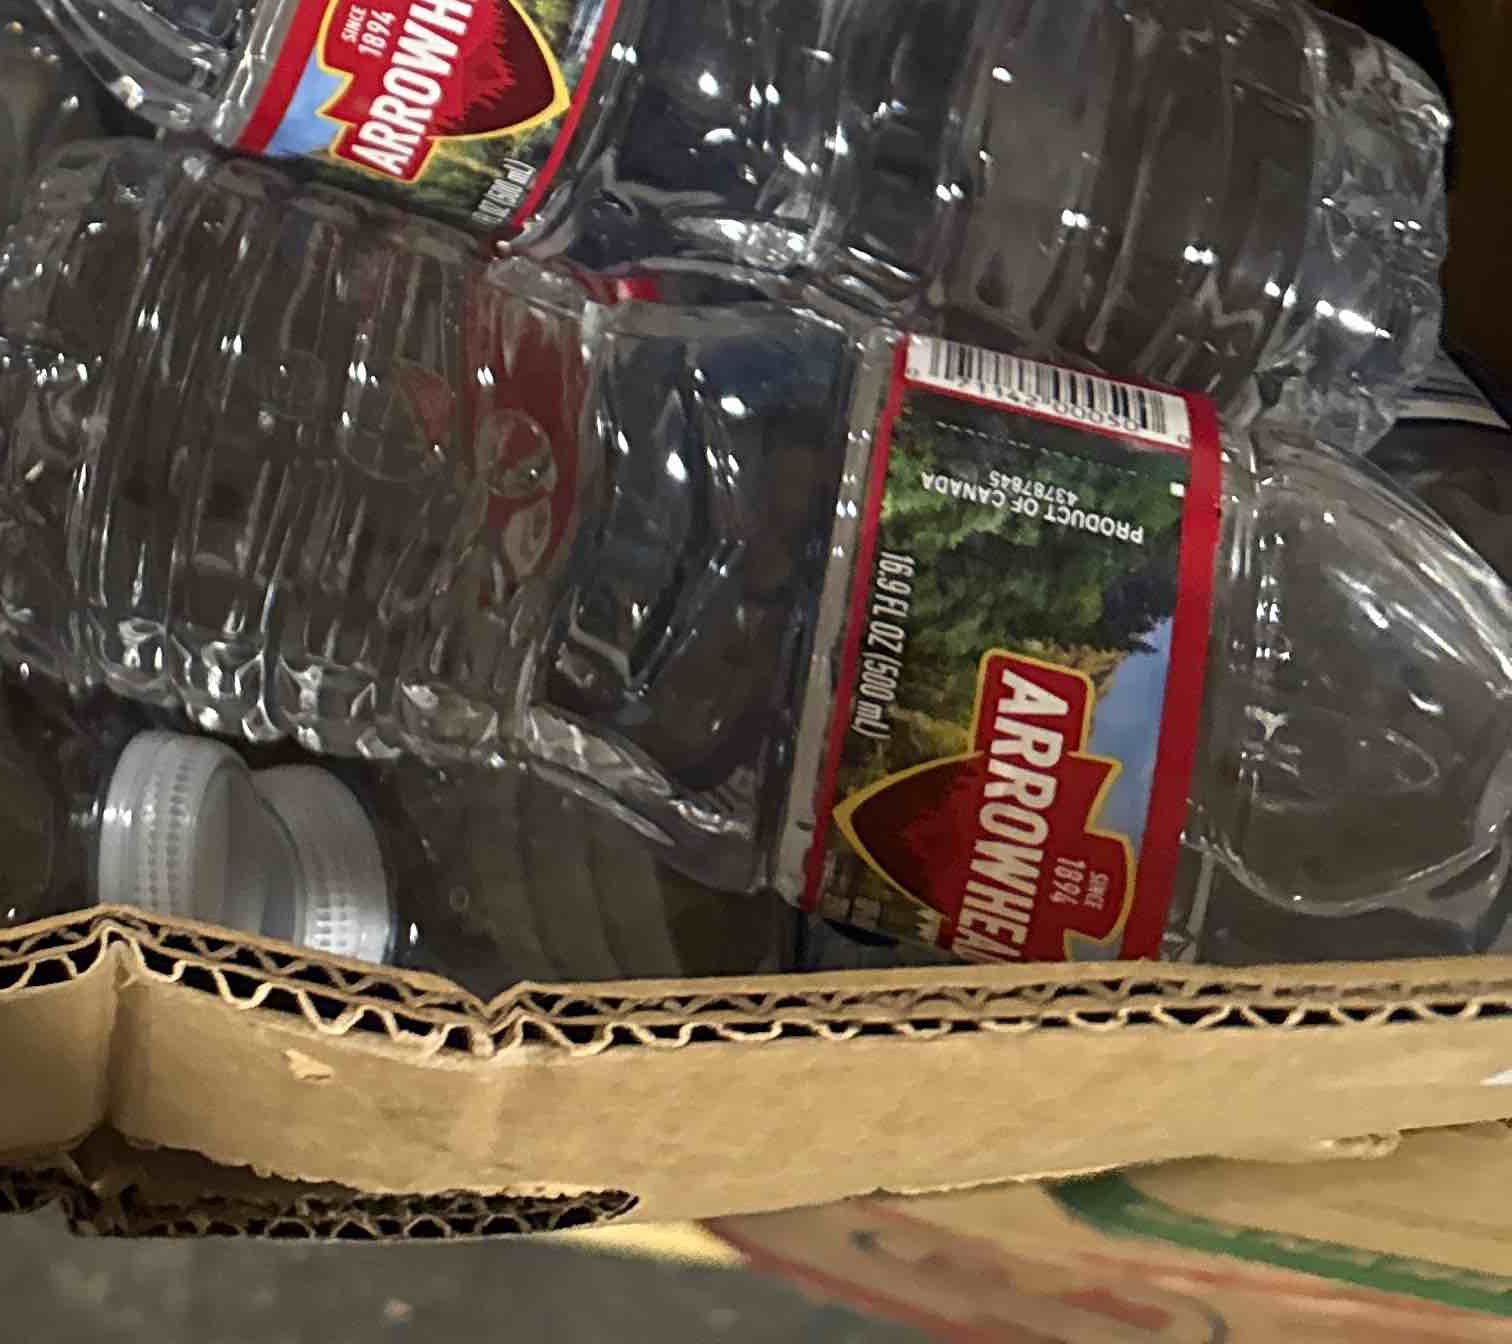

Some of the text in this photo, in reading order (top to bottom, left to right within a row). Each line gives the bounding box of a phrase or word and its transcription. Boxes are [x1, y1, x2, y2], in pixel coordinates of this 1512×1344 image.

[340, 4, 366, 44] SINCE
[358, 9, 395, 57] 1894
[920, 470, 1145, 545] PRODUCT OF CANADA
[988, 469, 1081, 508] 43787845
[877, 553, 915, 594] 16.9
[860, 652, 901, 700] (500
[852, 701, 890, 739] mL)
[950, 668, 1070, 961] ARROWHEA
[1050, 857, 1085, 906] 1894
